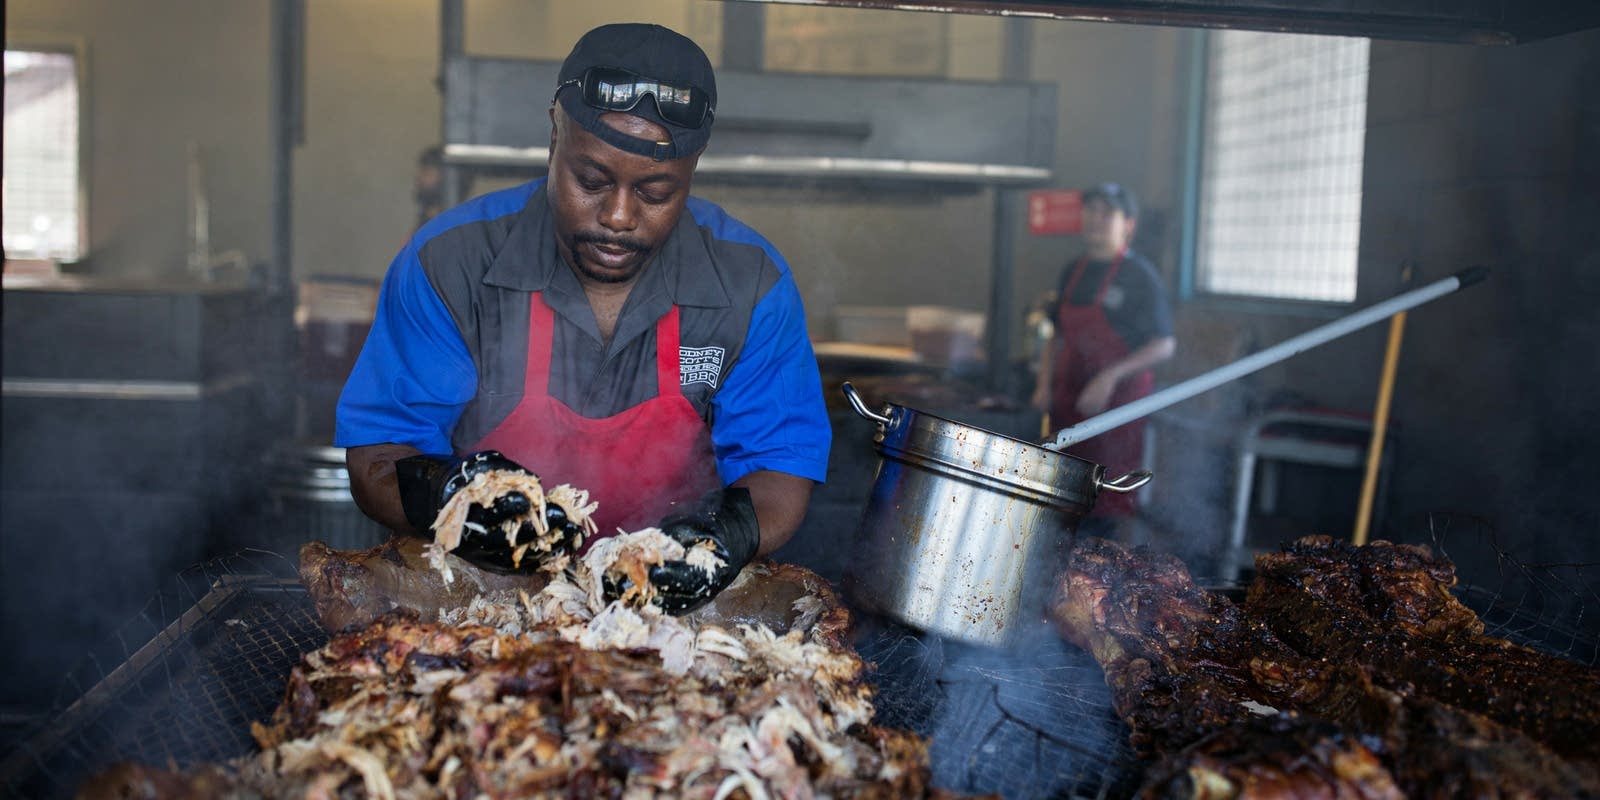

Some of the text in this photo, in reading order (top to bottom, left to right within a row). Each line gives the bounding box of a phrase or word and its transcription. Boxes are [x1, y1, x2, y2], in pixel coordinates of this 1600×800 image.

[679, 349, 722, 357] ODNEY
[679, 356, 720, 364] COTT'S
[687, 371, 716, 384] BBQ
